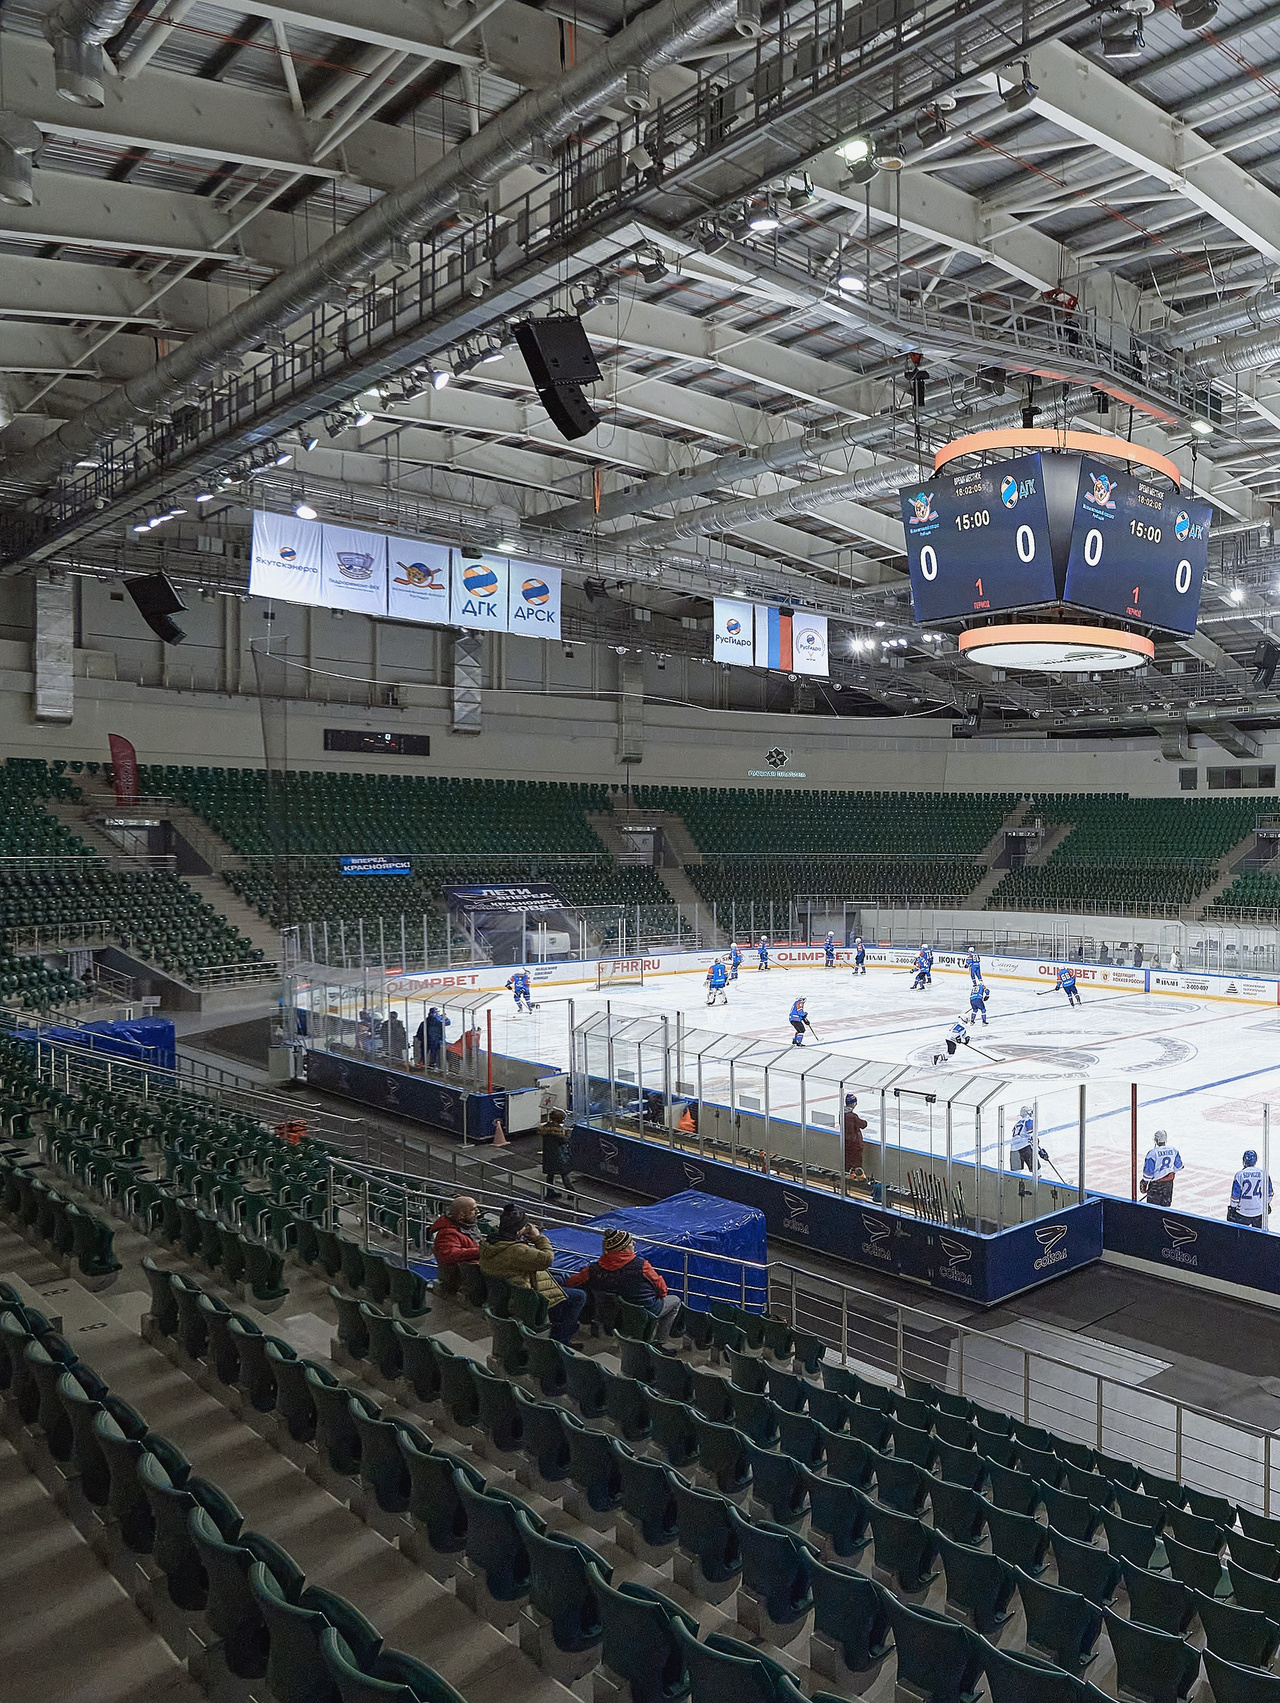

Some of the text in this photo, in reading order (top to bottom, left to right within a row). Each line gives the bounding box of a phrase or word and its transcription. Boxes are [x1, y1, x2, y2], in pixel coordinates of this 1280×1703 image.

[955, 483, 982, 497] 18:02:05
[1019, 478, 1036, 499] ДГК
[1137, 494, 1163, 510] 18:02:05
[955, 509, 990, 532] 15:00
[1129, 519, 1162, 544] 15:00
[1189, 523, 1204, 541] ДГК
[1016, 524, 1036, 563] 0
[1084, 528, 1103, 567] 0
[255, 556, 319, 574] Якутскэнерго
[919, 545, 938, 582] 0
[1175, 559, 1192, 594] 0
[975, 578, 984, 597] 1
[1132, 586, 1140, 604] 1
[462, 599, 498, 618] ДГК
[514, 606, 556, 624] ДРСК
[715, 633, 752, 648] РусГидро
[343, 861, 411, 872] КРАСНОЯРСК!
[482, 888, 532, 896] ЛЕТИ
[777, 951, 854, 962] OLIMPET
[938, 955, 956, 965] IKON
[386, 973, 480, 994] OLIMPBET
[1241, 1180, 1262, 1199] 24
